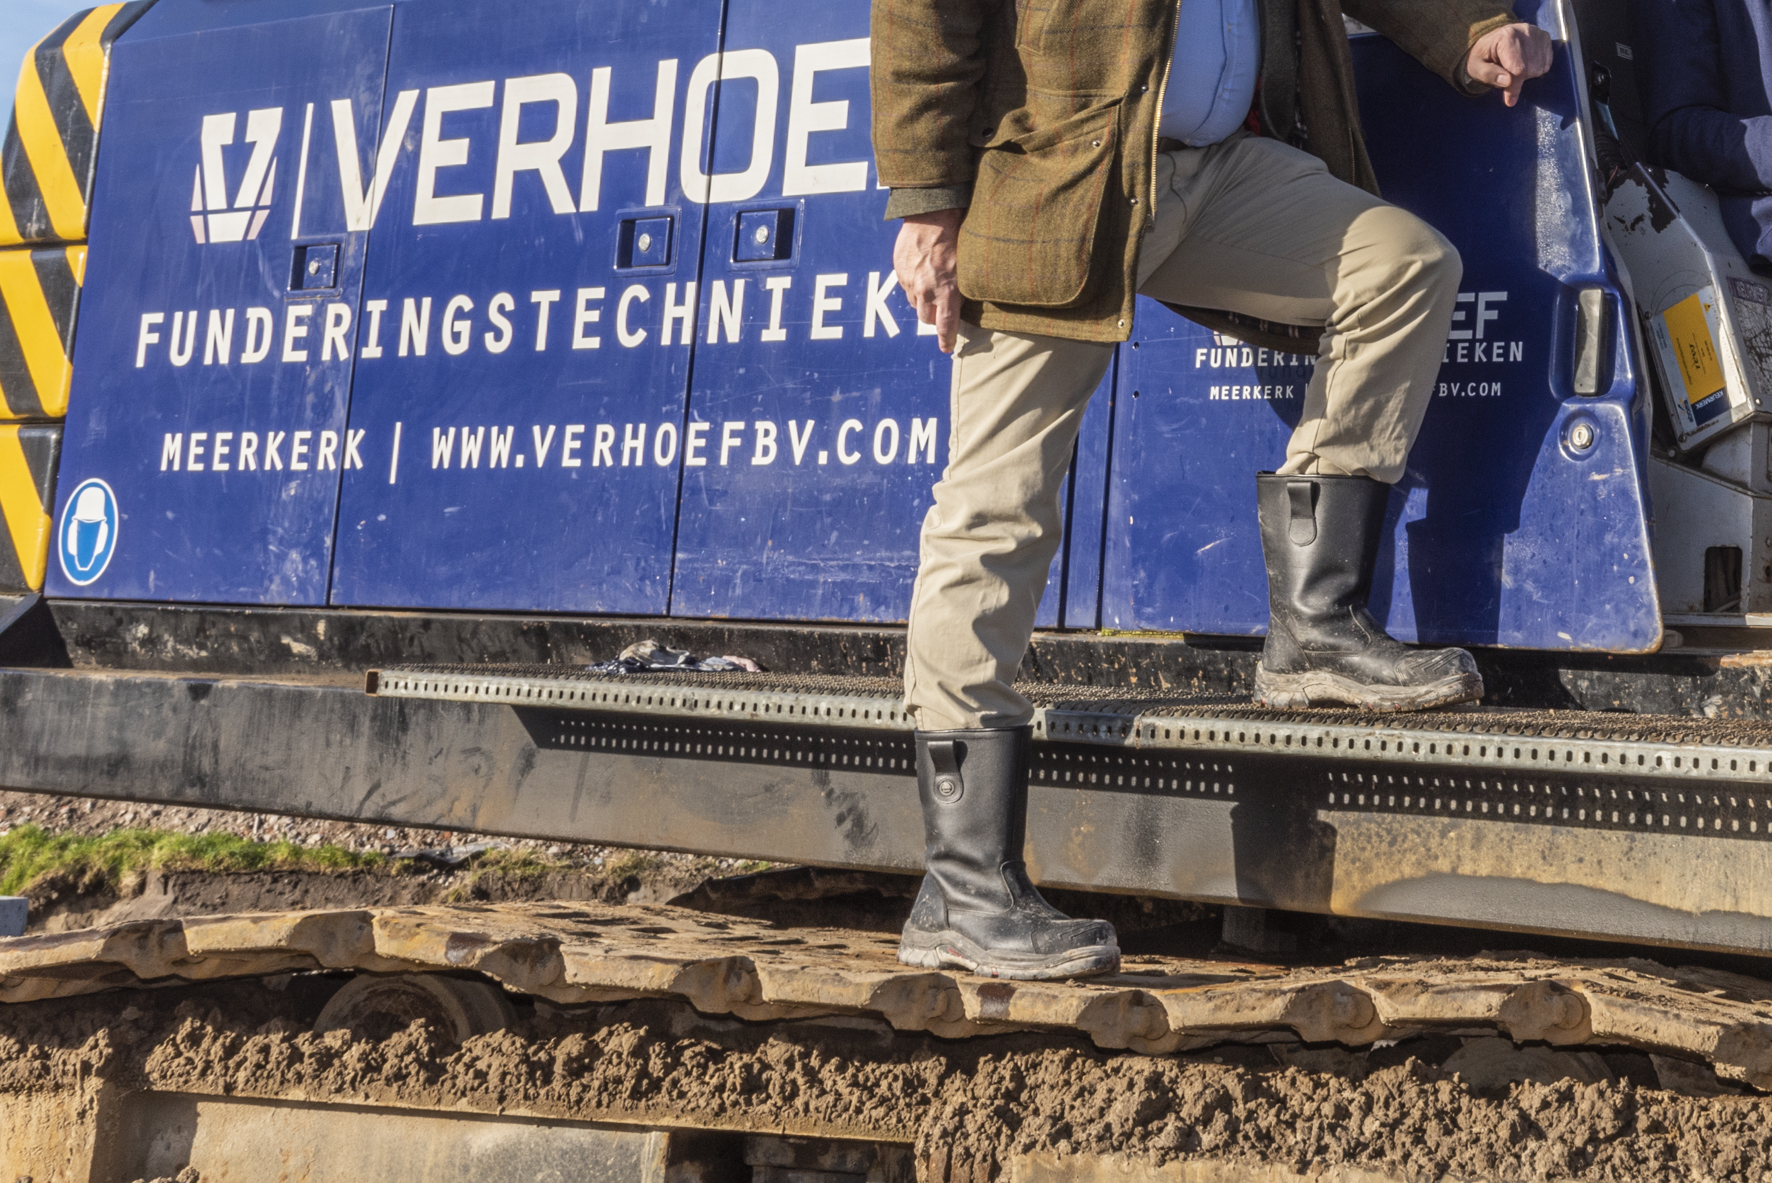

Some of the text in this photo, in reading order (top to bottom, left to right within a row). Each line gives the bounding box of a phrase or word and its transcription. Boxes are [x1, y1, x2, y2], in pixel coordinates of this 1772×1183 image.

[331, 35, 890, 233] VERHOE
[135, 271, 938, 369] FUNDERINGSTECHNIEK
[1209, 384, 1294, 401] MEERKERK
[1695, 390, 1724, 410] KEURMERK
[160, 428, 366, 472] MEERKERK
[431, 417, 938, 470] WWW.VERHOEFBV.COM
